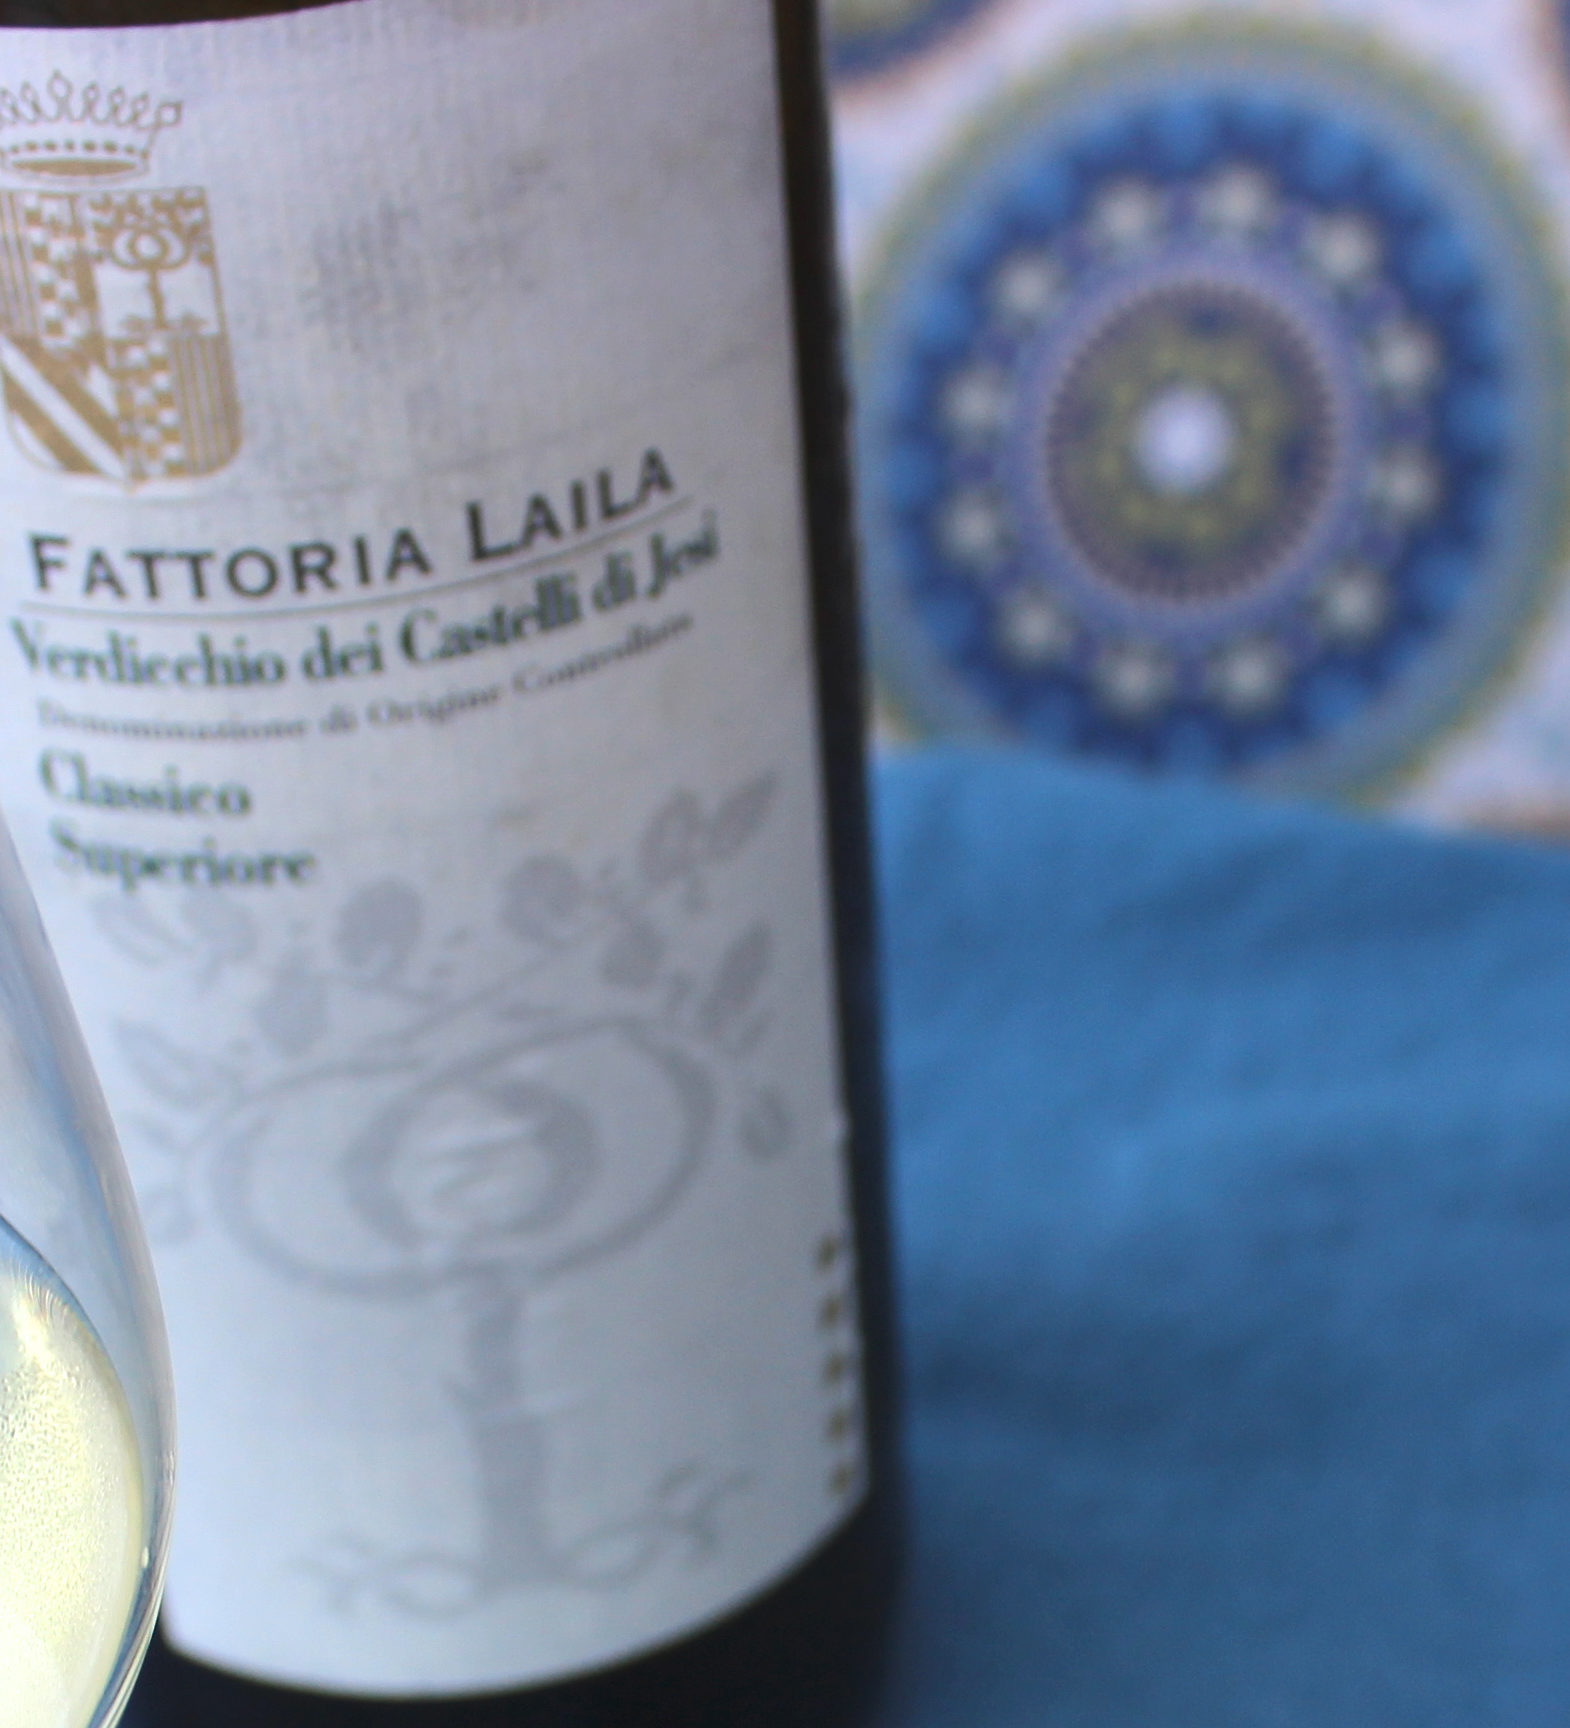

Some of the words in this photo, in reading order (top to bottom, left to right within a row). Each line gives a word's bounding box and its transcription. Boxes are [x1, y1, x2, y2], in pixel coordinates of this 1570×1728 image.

[27, 526, 434, 602] FATTORIA
[464, 446, 675, 563] LAILA
[8, 616, 288, 688] Verdicchio
[300, 621, 386, 683] dei
[398, 572, 583, 665] Castelli
[590, 552, 636, 613] di
[642, 506, 720, 600] Jesi
[36, 746, 254, 817] Classico
[47, 814, 319, 893] Superiore
